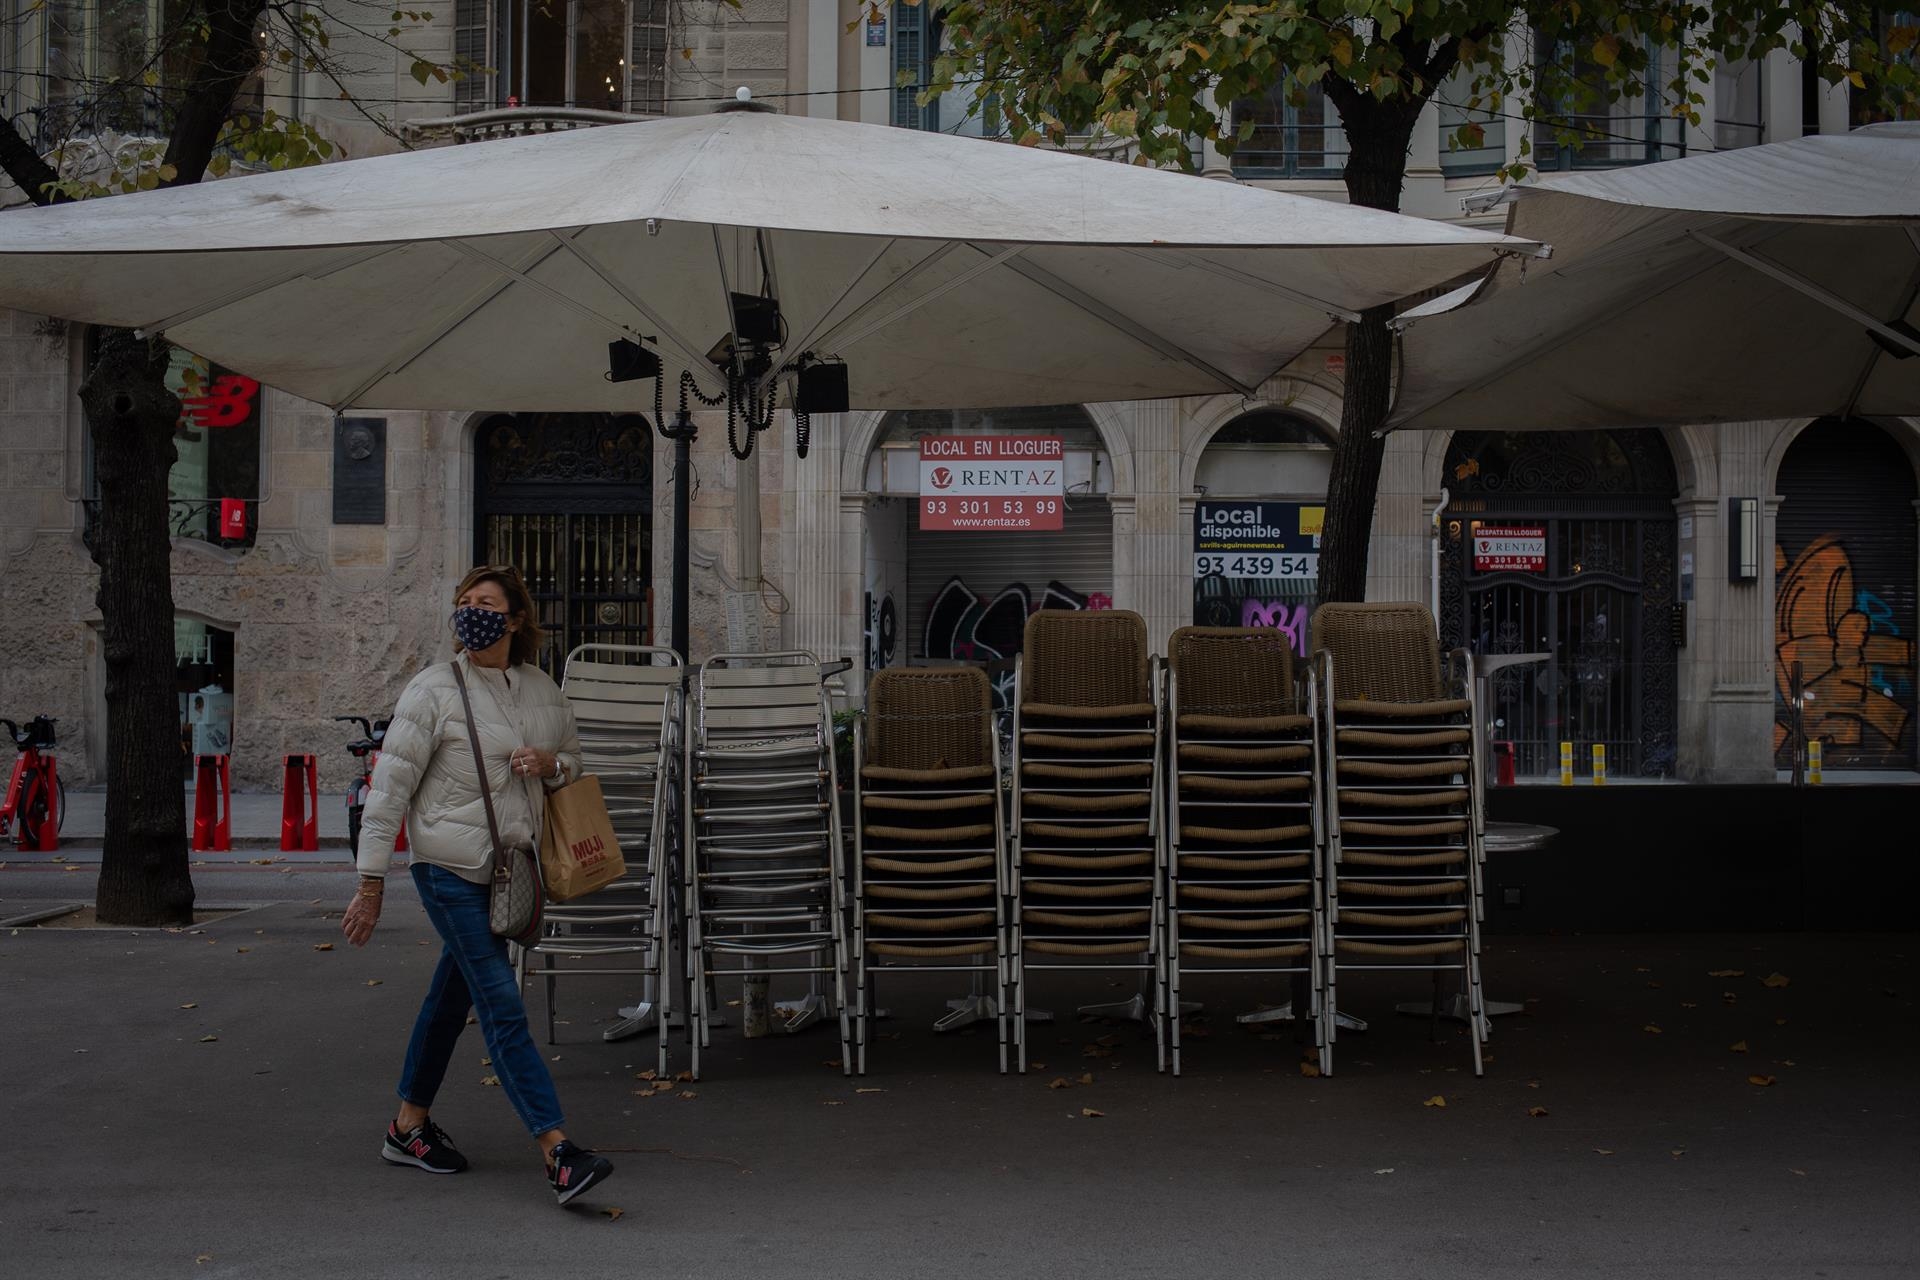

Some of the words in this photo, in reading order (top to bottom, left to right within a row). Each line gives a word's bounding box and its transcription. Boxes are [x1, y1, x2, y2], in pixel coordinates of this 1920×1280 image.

[924, 440, 967, 456] LOCAL
[974, 440, 992, 455] EN
[999, 440, 1061, 456] LLOGUER
[962, 470, 1056, 486] RENTAZ
[927, 501, 947, 514] 93
[960, 501, 990, 514] 301
[1003, 501, 1023, 514] 53
[1036, 501, 1056, 514] 99
[1201, 506, 1262, 524] Local
[952, 516, 1031, 527] www.rentaz.es
[1200, 525, 1281, 540] disponible
[1496, 543, 1543, 552] RENTAZ
[1197, 557, 1224, 574] 93
[1231, 557, 1274, 575] 439
[1281, 557, 1309, 575] 54
[1479, 556, 1490, 564] 93
[1495, 556, 1511, 564] 301
[1516, 556, 1527, 564] 53
[1531, 556, 1543, 564] 99
[572, 834, 604, 861] MUJI
